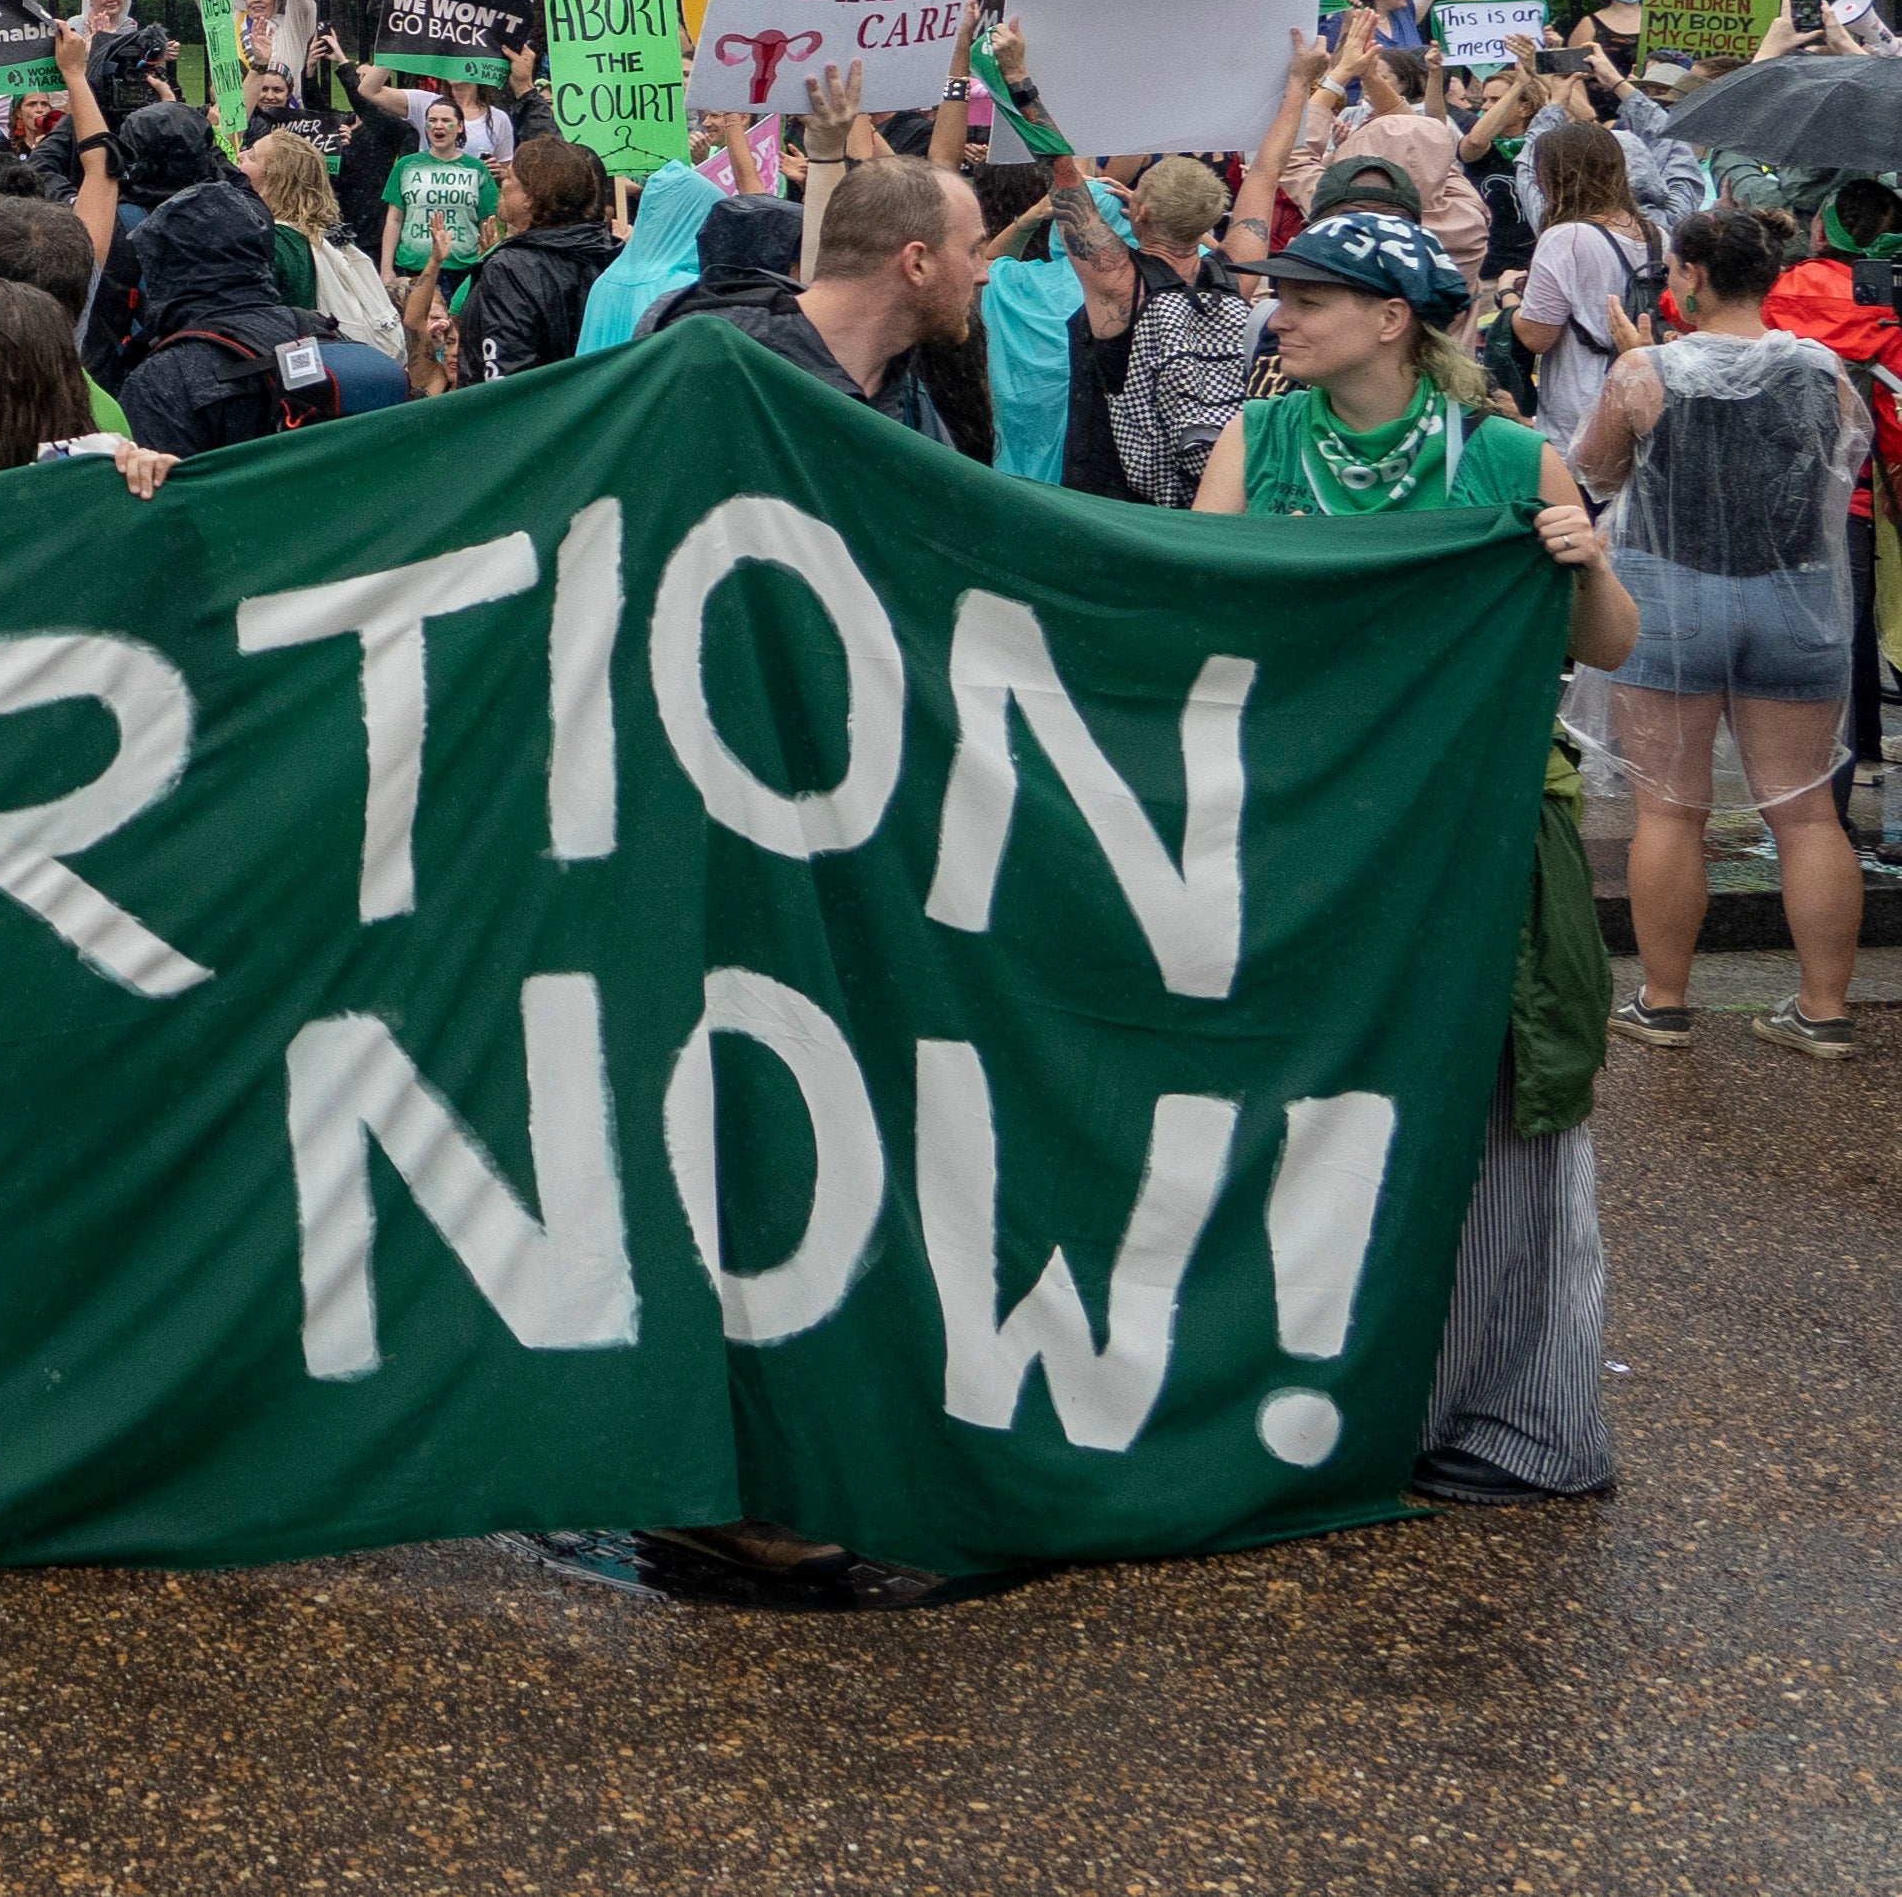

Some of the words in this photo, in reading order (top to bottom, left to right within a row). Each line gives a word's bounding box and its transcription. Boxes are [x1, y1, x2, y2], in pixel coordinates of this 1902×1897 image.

[857, 2, 962, 50] CARE
[1442, 5, 1477, 27] This
[1487, 7, 1506, 24] is
[1648, 10, 1685, 30] MY
[1689, 14, 1756, 34] BODY
[388, 12, 423, 34] GO
[428, 17, 488, 49] BACK
[1647, 28, 1682, 47] MY
[1683, 31, 1761, 52] CHOICE
[586, 51, 645, 75] THE
[28, 75, 66, 87] MARC
[557, 82, 682, 127] COURT
[410, 171, 422, 184] A
[431, 172, 472, 186] MOM
[402, 189, 421, 206] BY
[285, 964, 1396, 1466] NOW!
